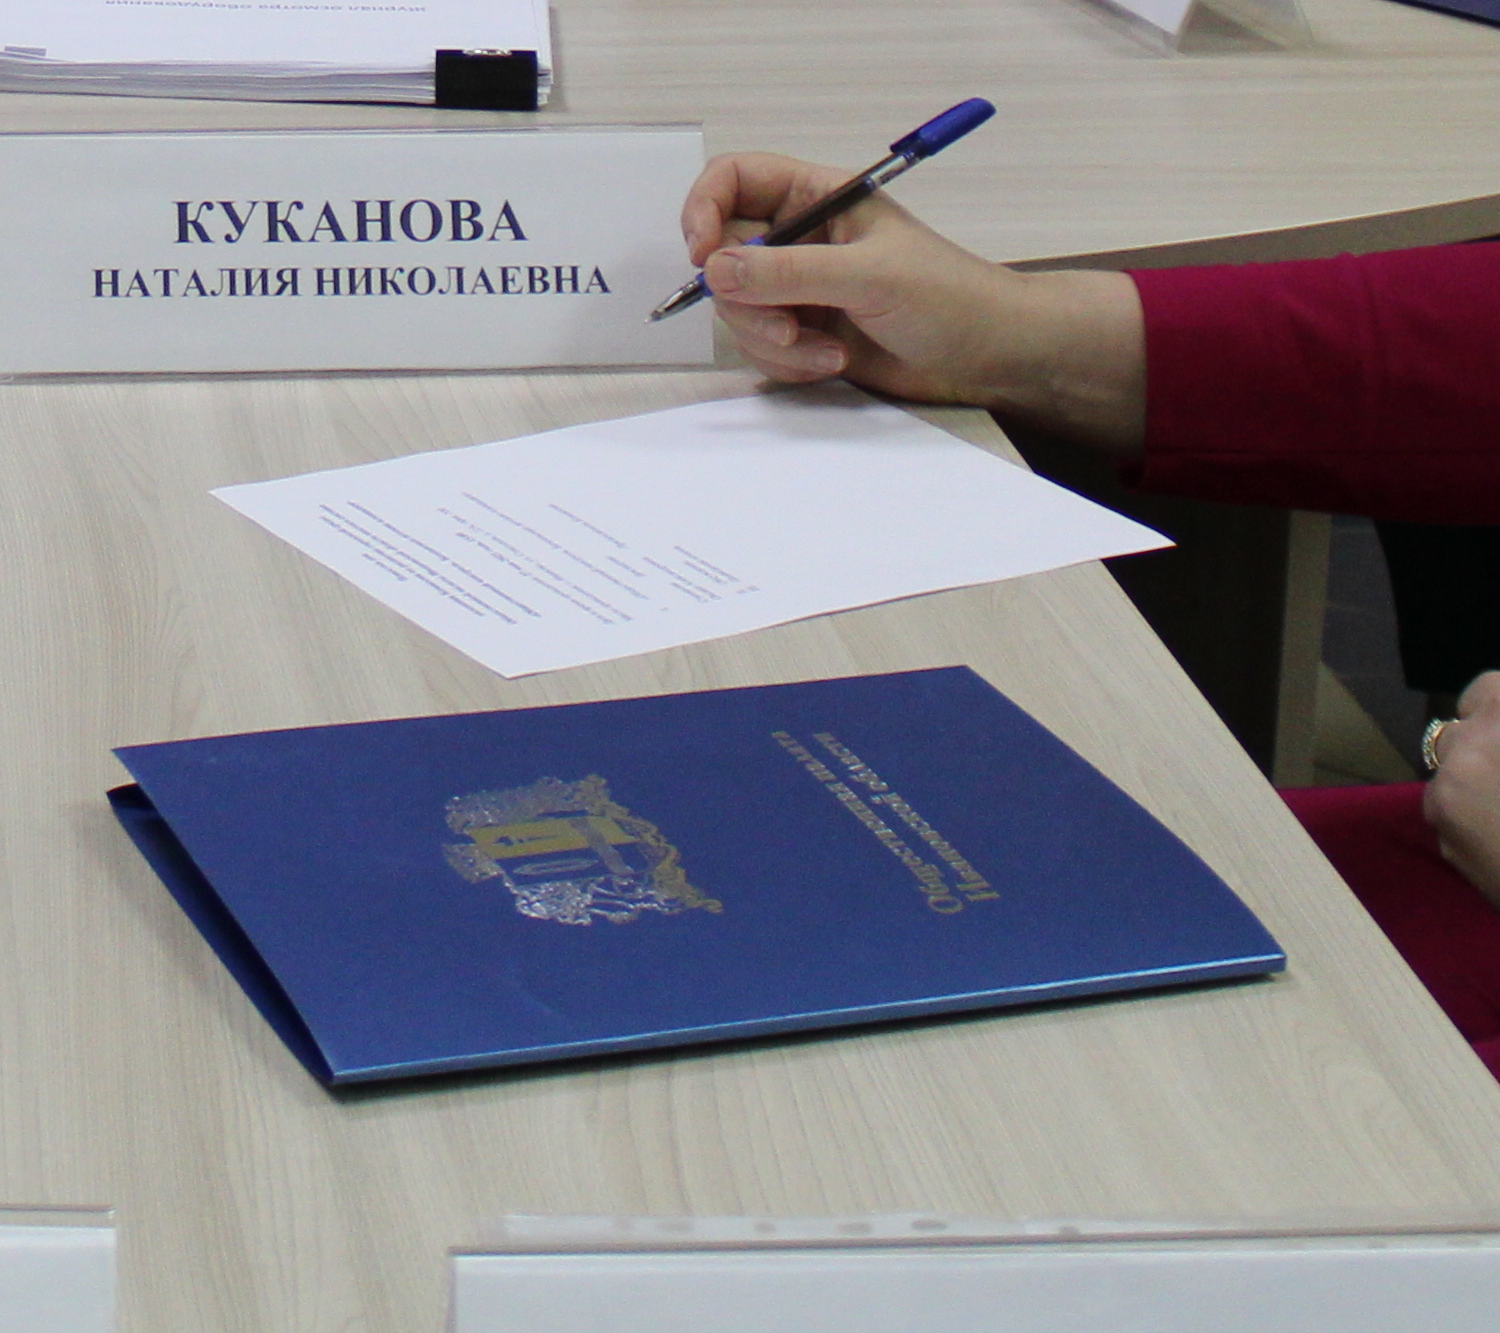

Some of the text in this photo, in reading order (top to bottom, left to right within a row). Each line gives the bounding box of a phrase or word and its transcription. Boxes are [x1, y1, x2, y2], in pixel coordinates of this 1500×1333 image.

[173, 198, 529, 244] КУКАНОВА
[93, 265, 612, 298] НАТАЛИЯ НИКОЛАЕВНА
